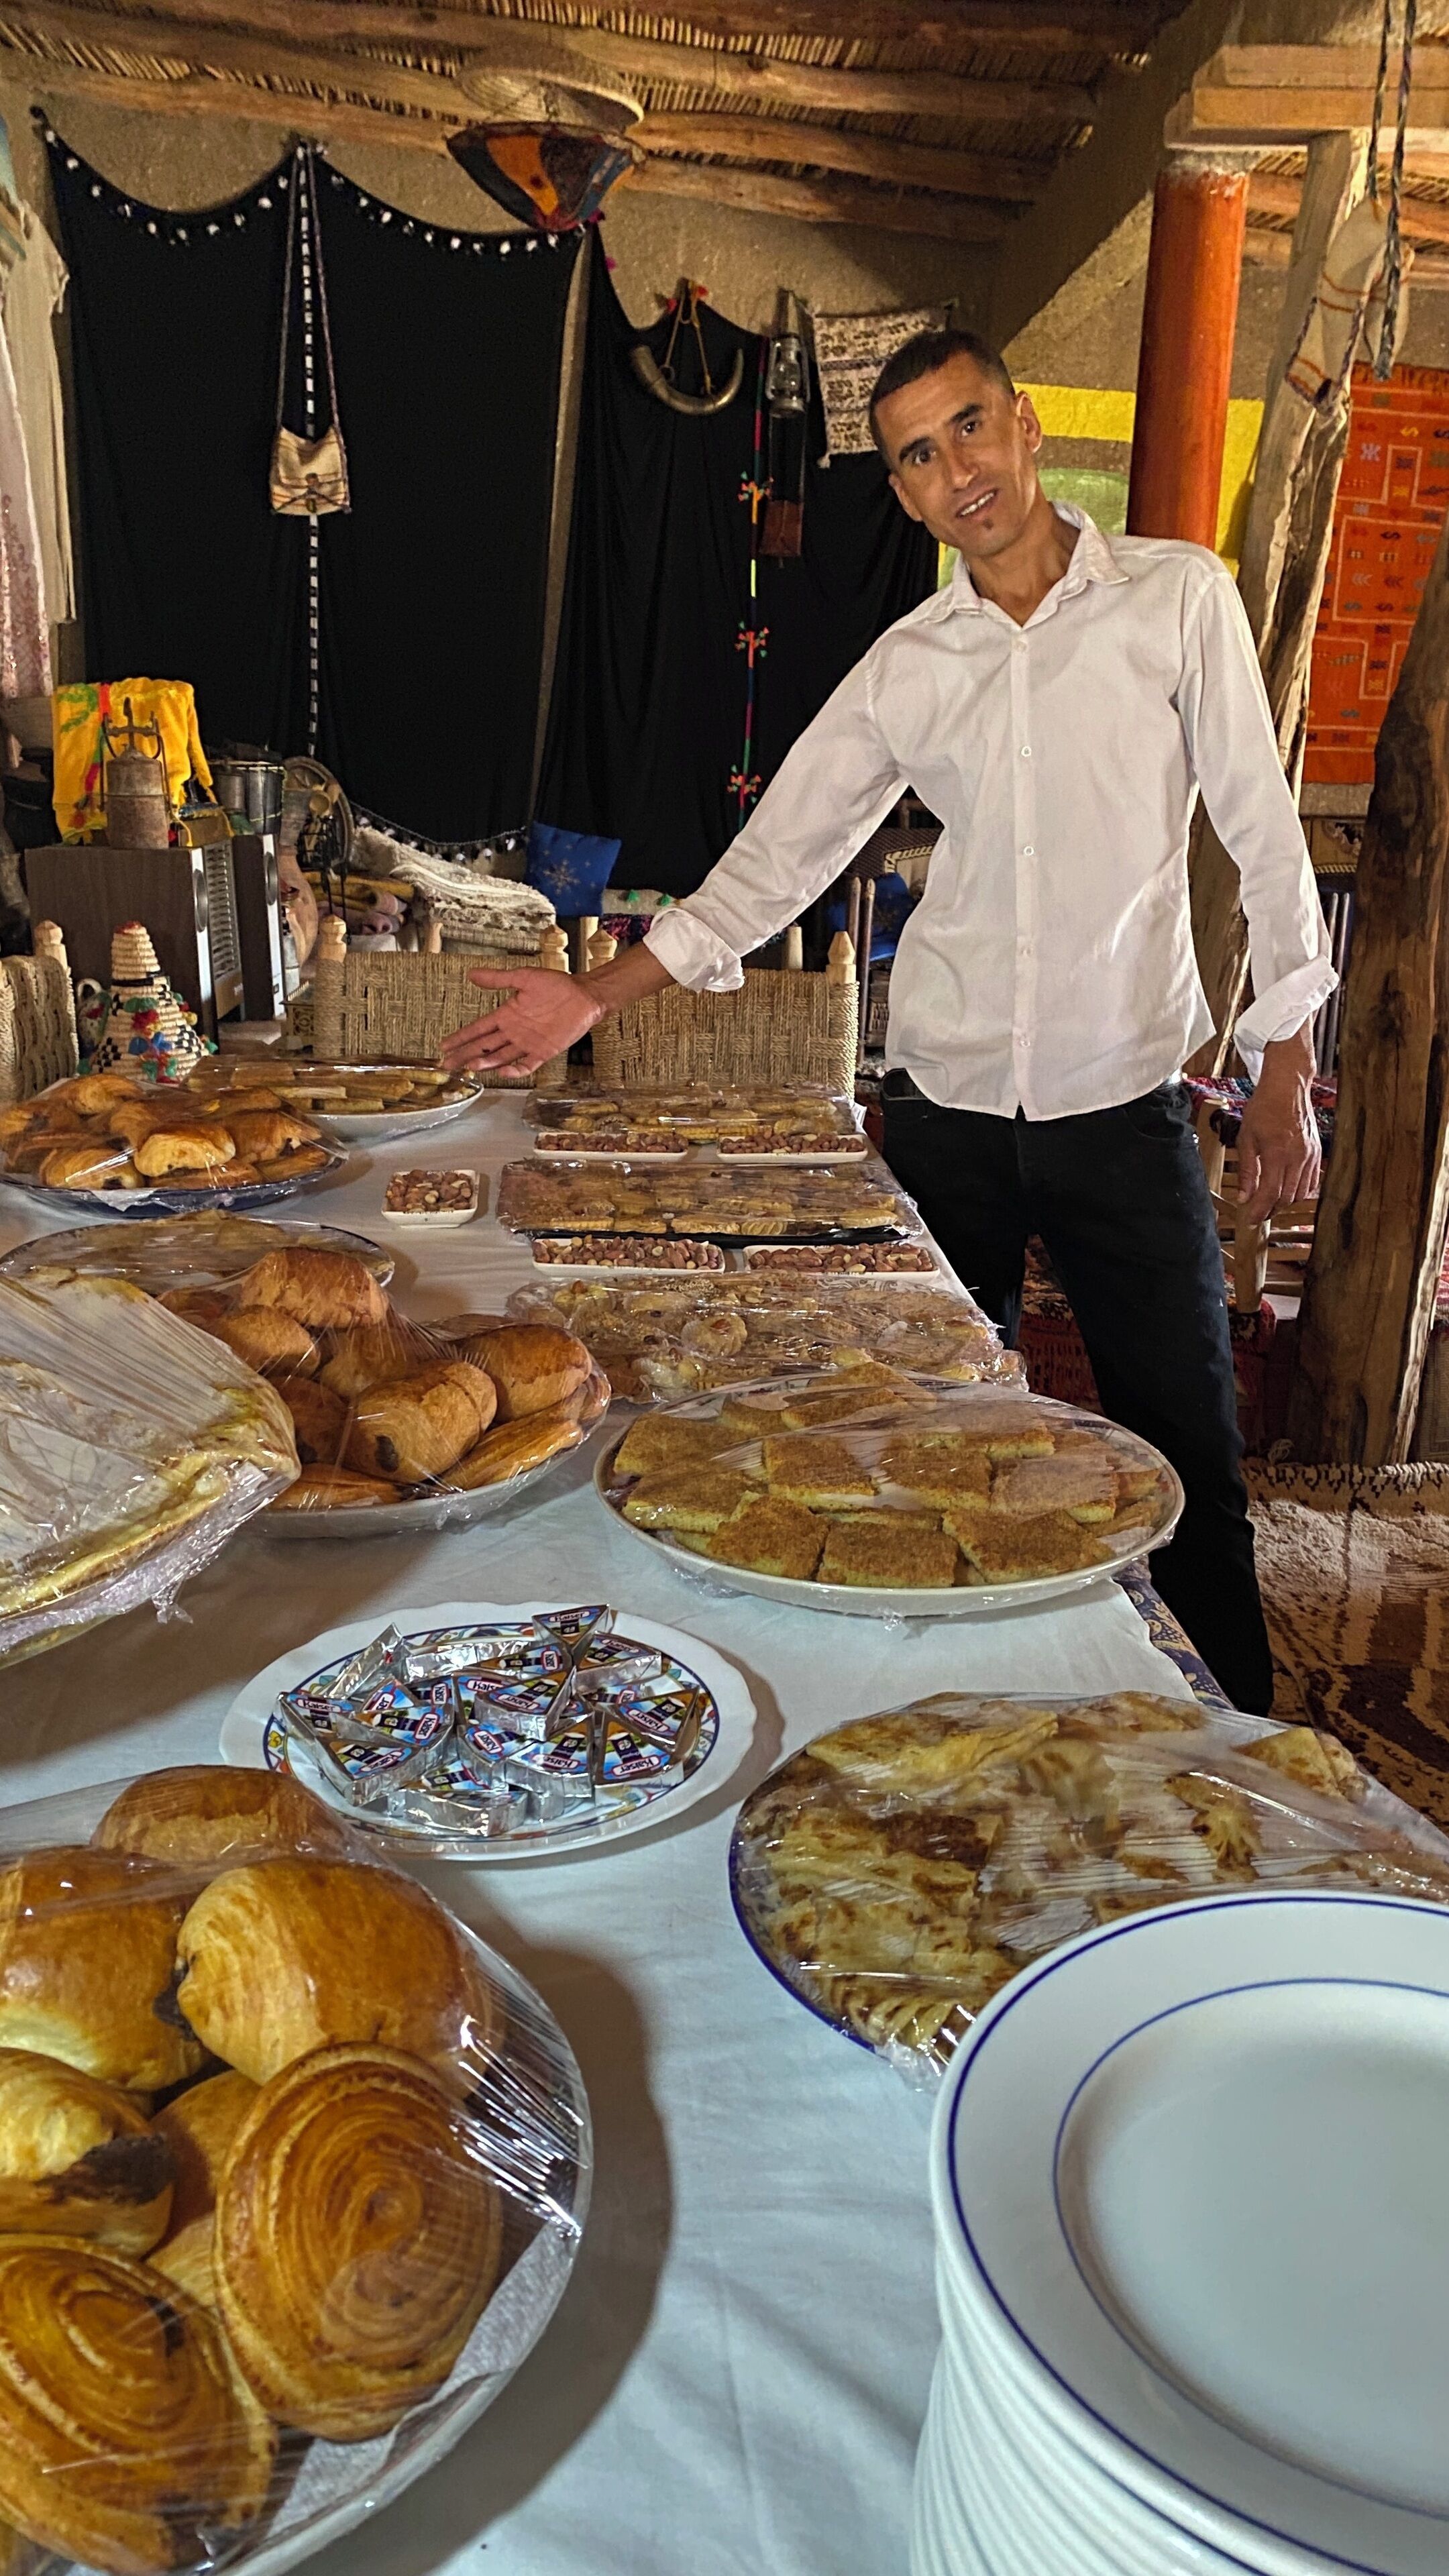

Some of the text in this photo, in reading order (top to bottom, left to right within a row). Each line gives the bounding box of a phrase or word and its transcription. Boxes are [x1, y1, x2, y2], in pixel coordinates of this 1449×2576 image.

[473, 1680, 502, 1691] Kais
[302, 1699, 336, 1711] Kaiser
[418, 1717, 436, 1737] Kaiser
[634, 1711, 663, 1730] Kaiser
[478, 1733, 498, 1752] Kaiser
[543, 1754, 574, 1768] Kaise
[620, 1758, 654, 1773] Kaiser
